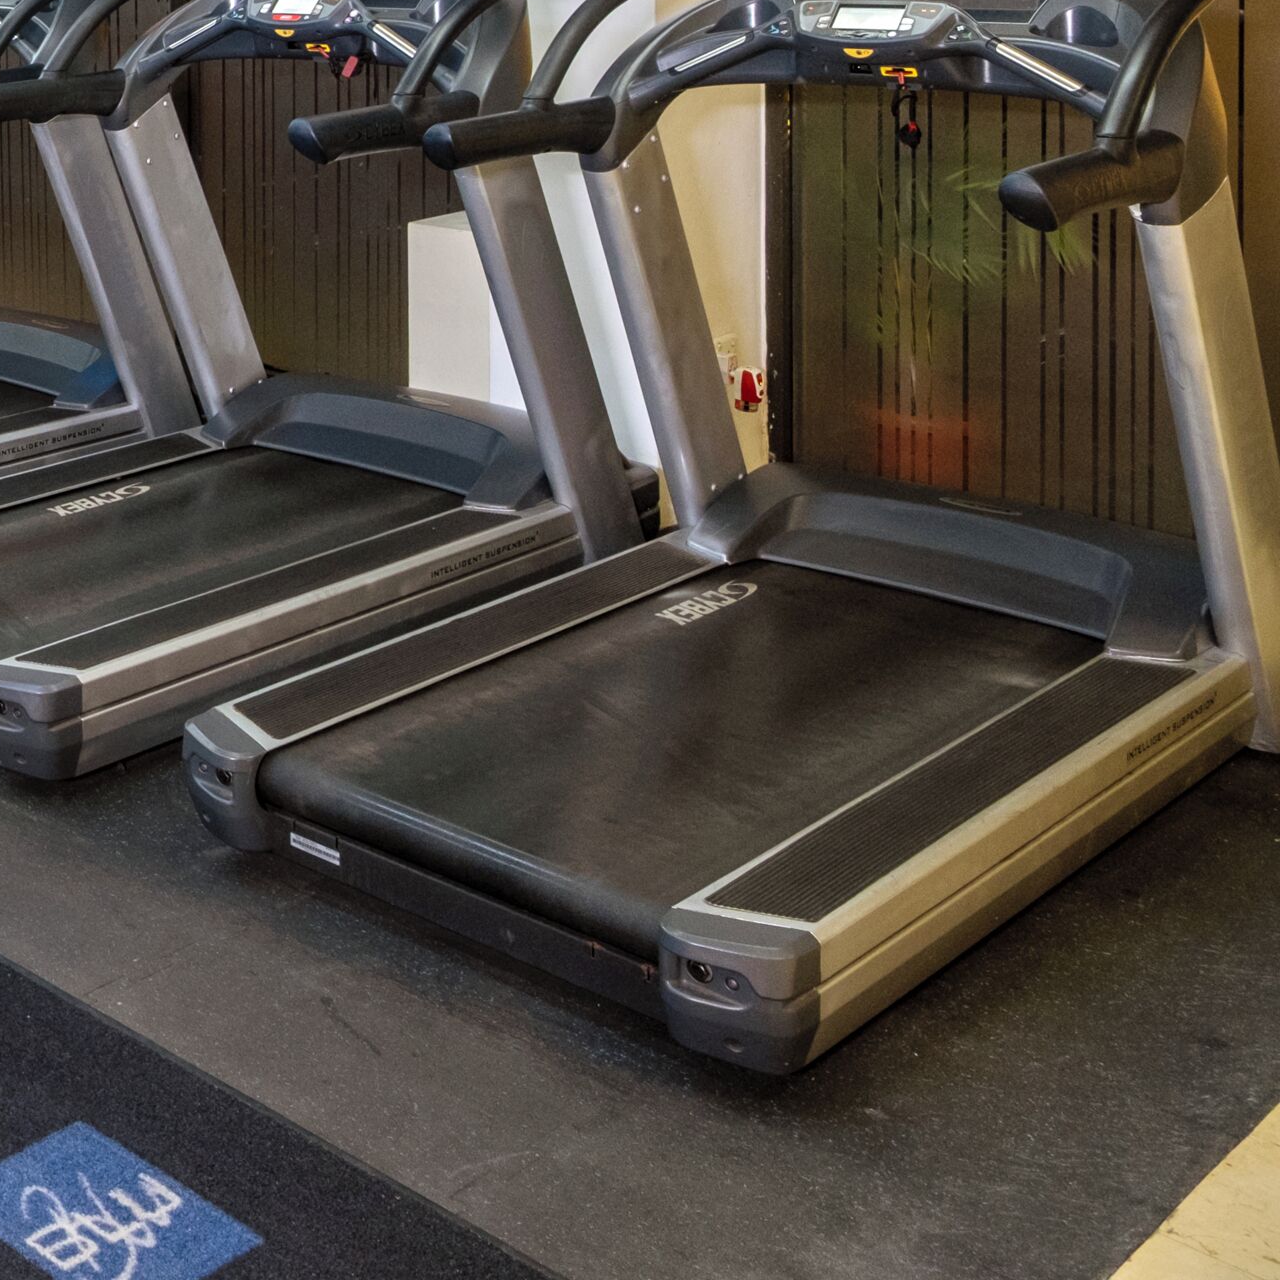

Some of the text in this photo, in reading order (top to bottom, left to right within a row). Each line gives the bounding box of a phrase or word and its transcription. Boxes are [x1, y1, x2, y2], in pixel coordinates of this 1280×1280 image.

[51, 426, 103, 444] SUSPENSION
[47, 488, 123, 518] CYBEX
[430, 536, 537, 578] INTELLIGENT SUSPENSION
[655, 591, 737, 626] CYBEX
[1125, 696, 1215, 761] INTELLIGENT SUSPENSION
